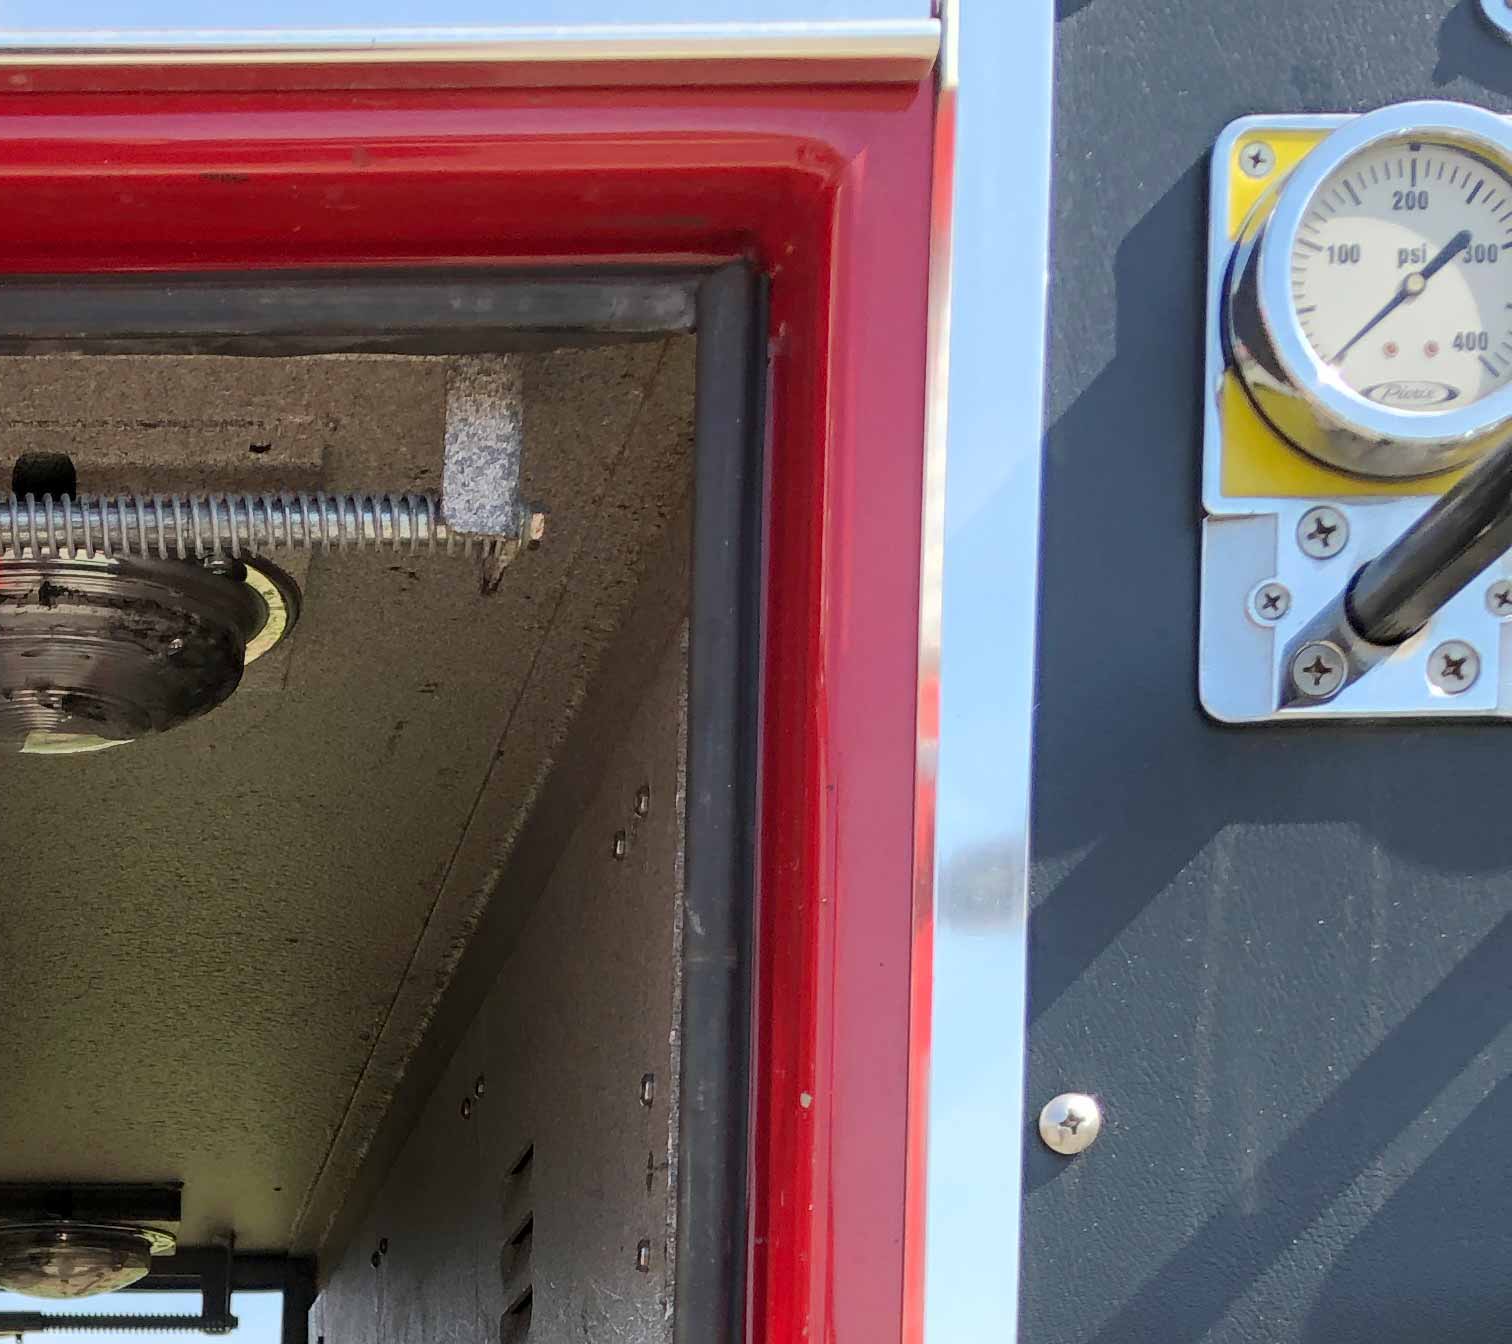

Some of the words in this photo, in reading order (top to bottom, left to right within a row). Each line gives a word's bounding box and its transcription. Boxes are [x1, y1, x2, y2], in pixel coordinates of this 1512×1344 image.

[1392, 191, 1429, 210] 200
[1327, 244, 1361, 264] 100
[1398, 244, 1427, 268] psi
[1462, 244, 1498, 263] 300
[1452, 331, 1488, 351] 400
